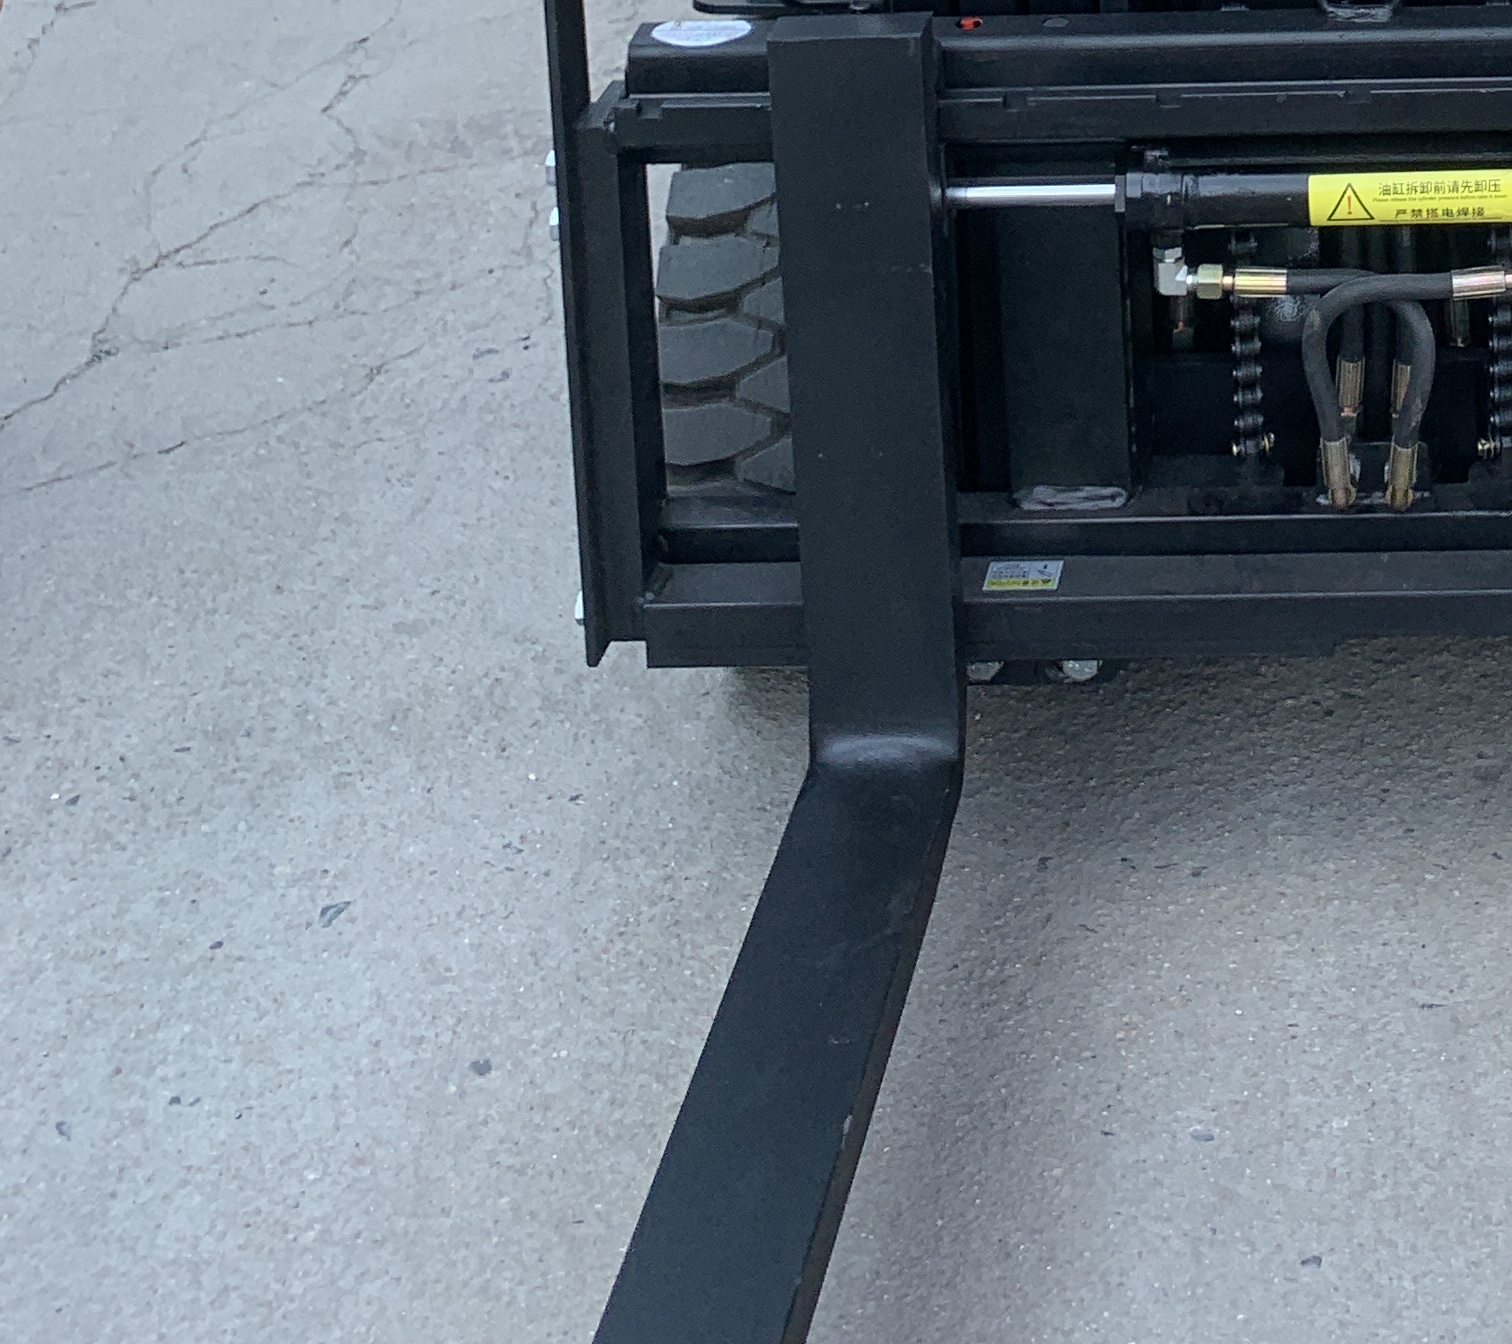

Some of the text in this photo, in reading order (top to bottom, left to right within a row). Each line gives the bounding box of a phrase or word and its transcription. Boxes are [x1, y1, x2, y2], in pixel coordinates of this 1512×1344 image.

[1378, 178, 1502, 196] 油缸拆卸前请先卸压
[1395, 206, 1486, 219] 严禁搭电焊接
